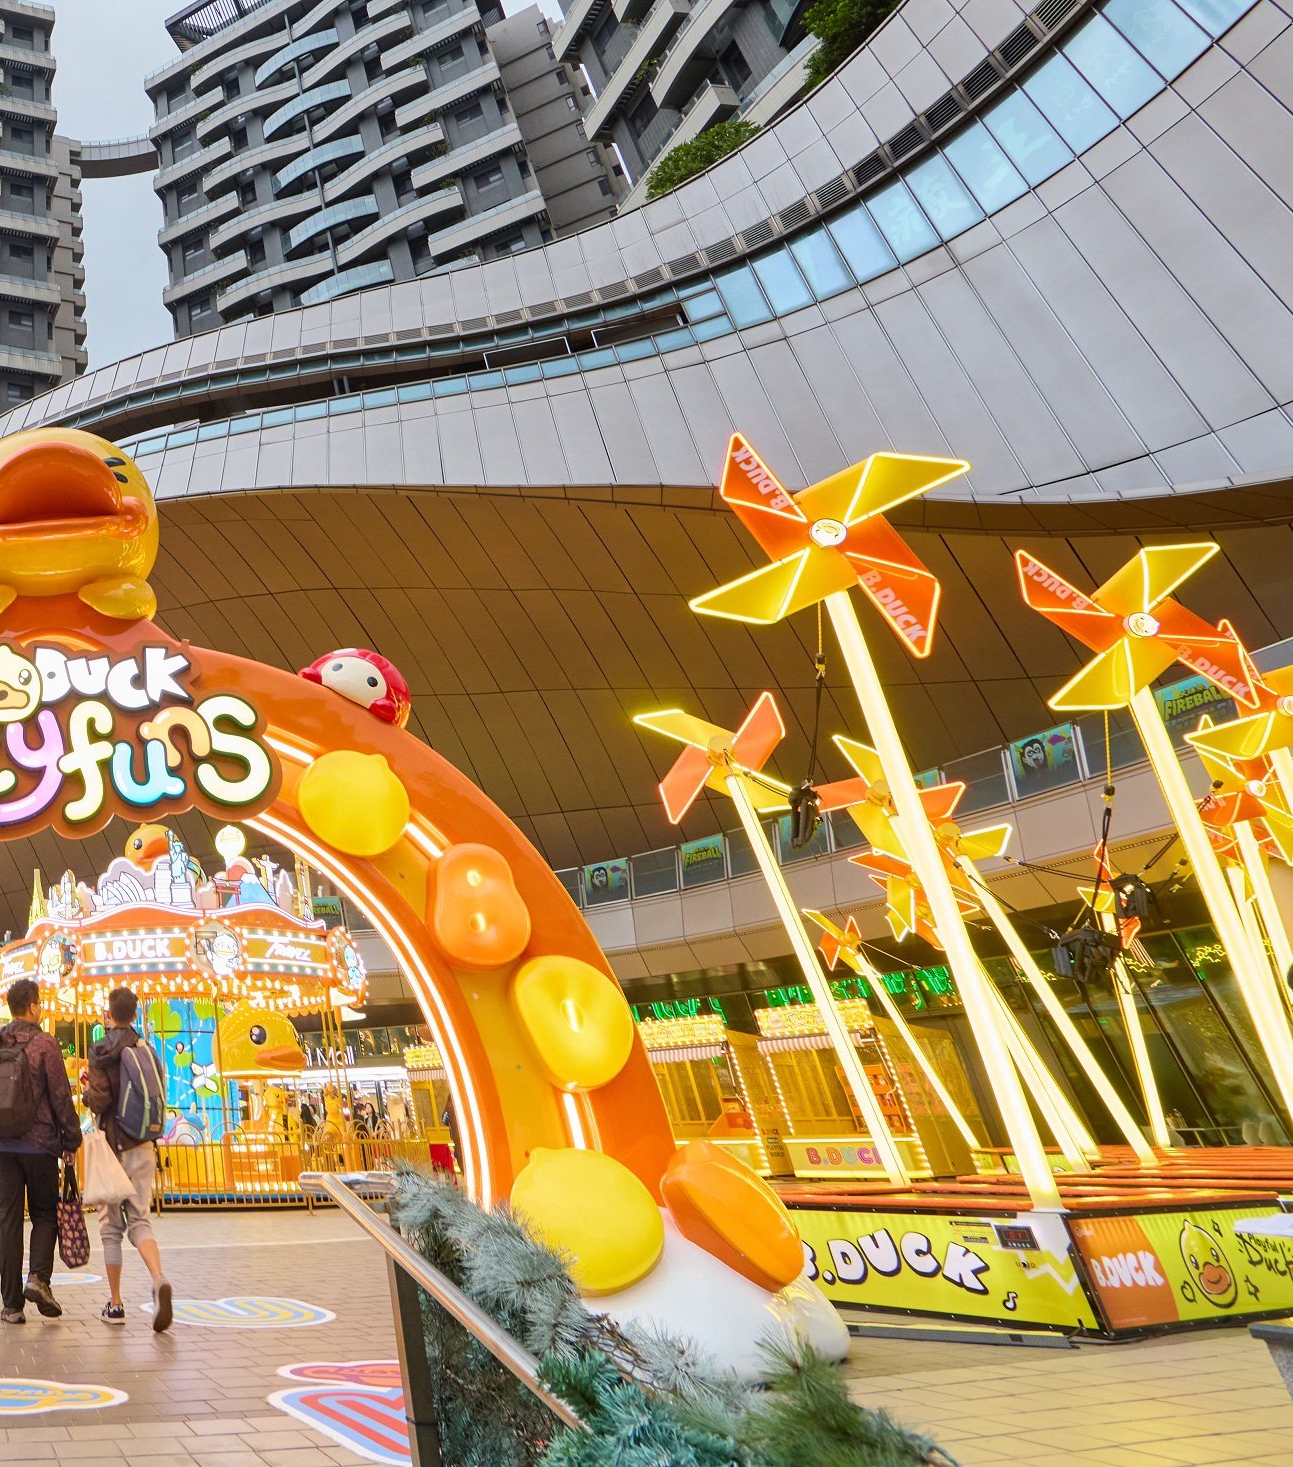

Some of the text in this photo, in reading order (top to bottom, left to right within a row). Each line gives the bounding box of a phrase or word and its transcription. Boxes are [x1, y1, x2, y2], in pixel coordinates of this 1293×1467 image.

[731, 444, 791, 511] B.DUCK
[861, 570, 928, 643] B.DUCK
[1023, 560, 1091, 611] B.DUCK
[1176, 644, 1252, 699] B.DUCK
[685, 847, 723, 867] FIREBALL
[94, 938, 172, 960] B.DUCK
[316, 1045, 356, 1067] Mall
[1091, 1250, 1165, 1288] B.DUCK
